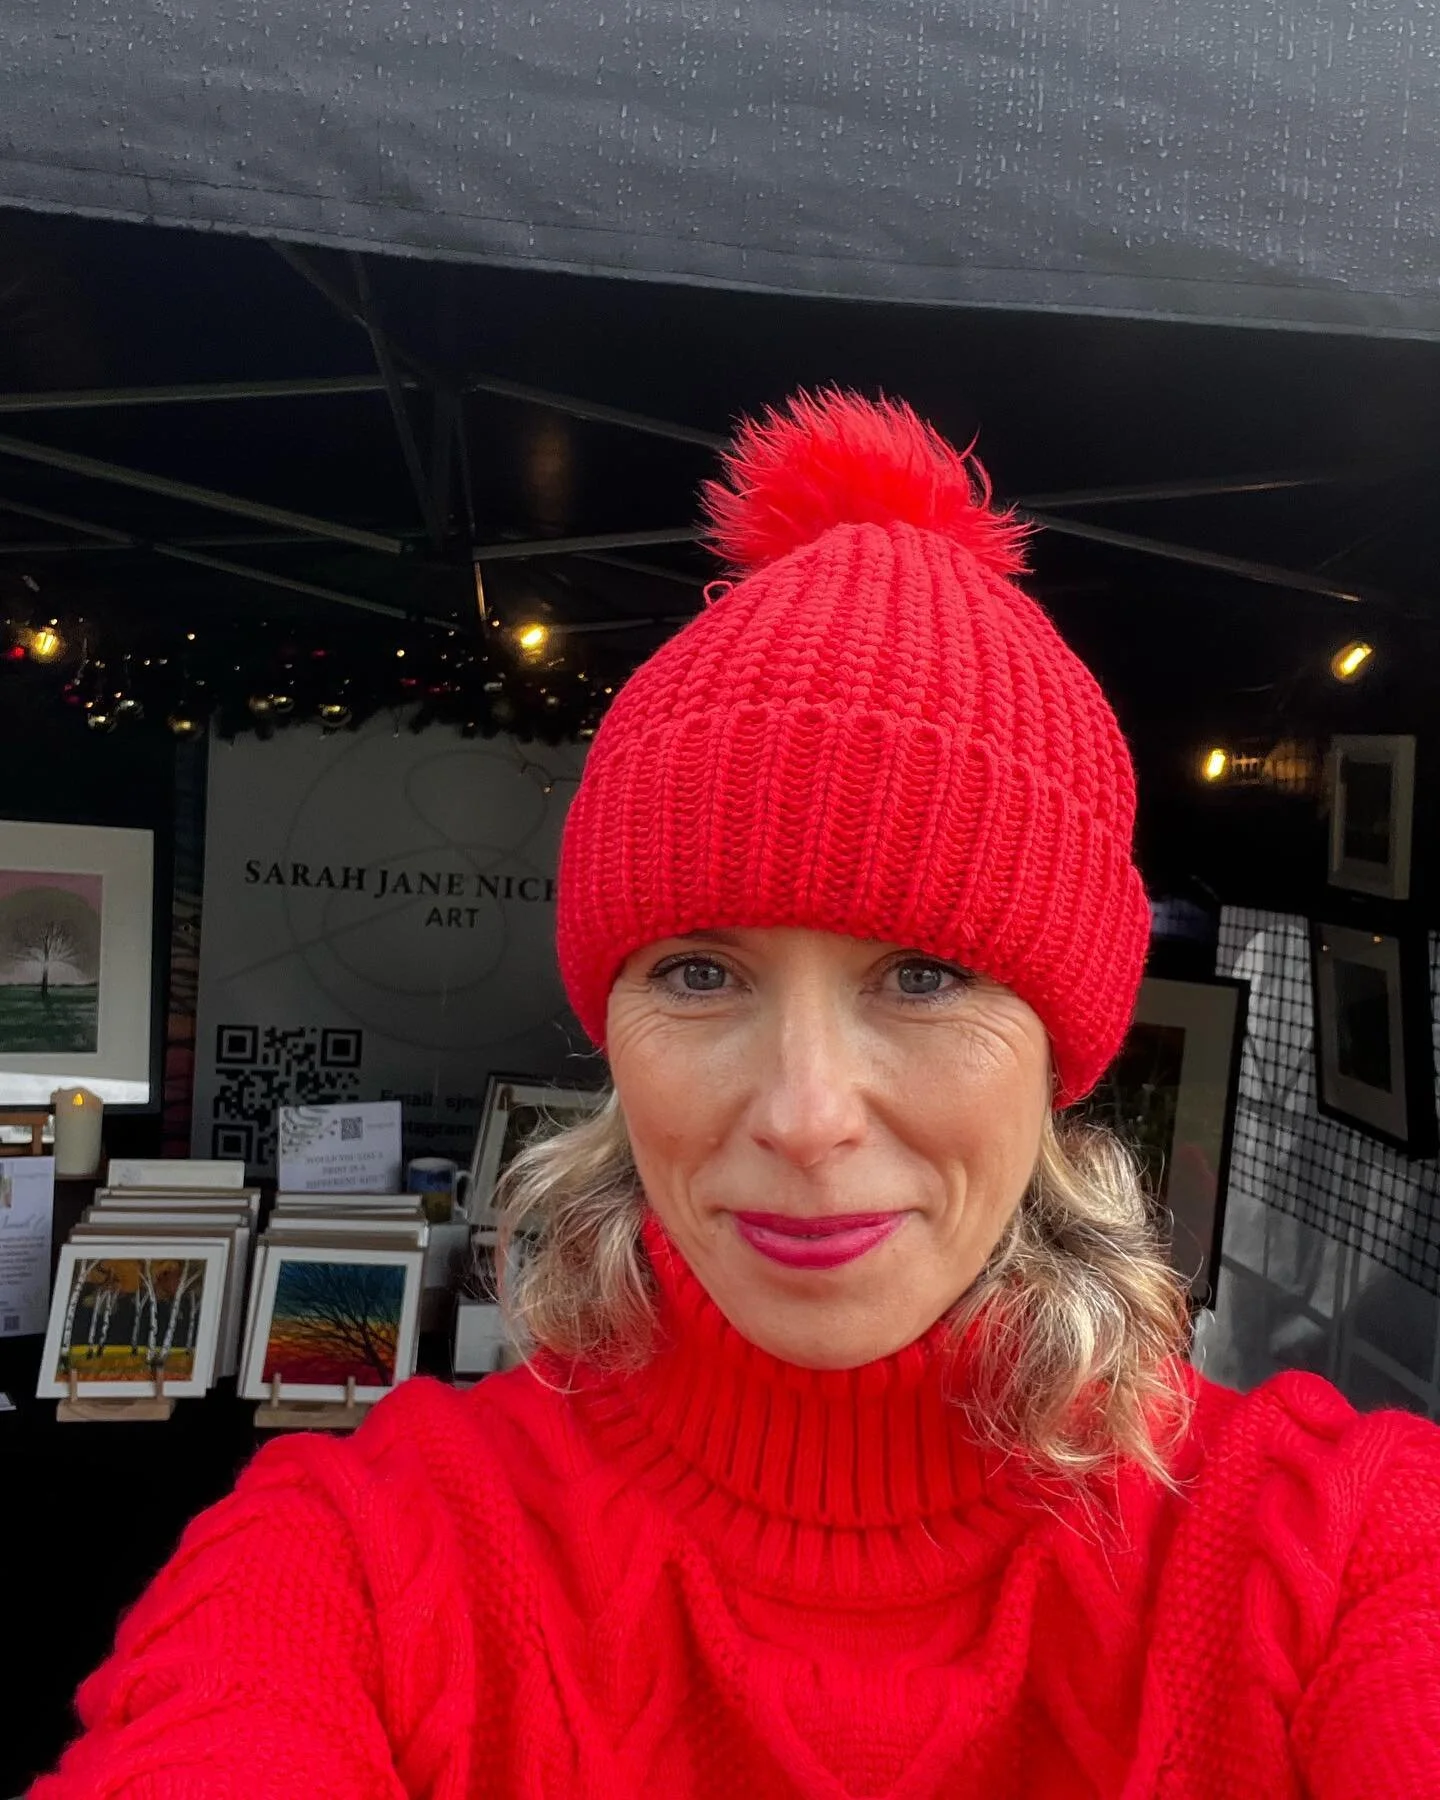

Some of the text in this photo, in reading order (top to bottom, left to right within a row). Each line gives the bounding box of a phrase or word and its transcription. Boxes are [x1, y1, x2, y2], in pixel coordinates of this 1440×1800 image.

[244, 859, 367, 891] SARAH
[373, 869, 466, 898] JANE
[425, 907, 480, 928] ART
